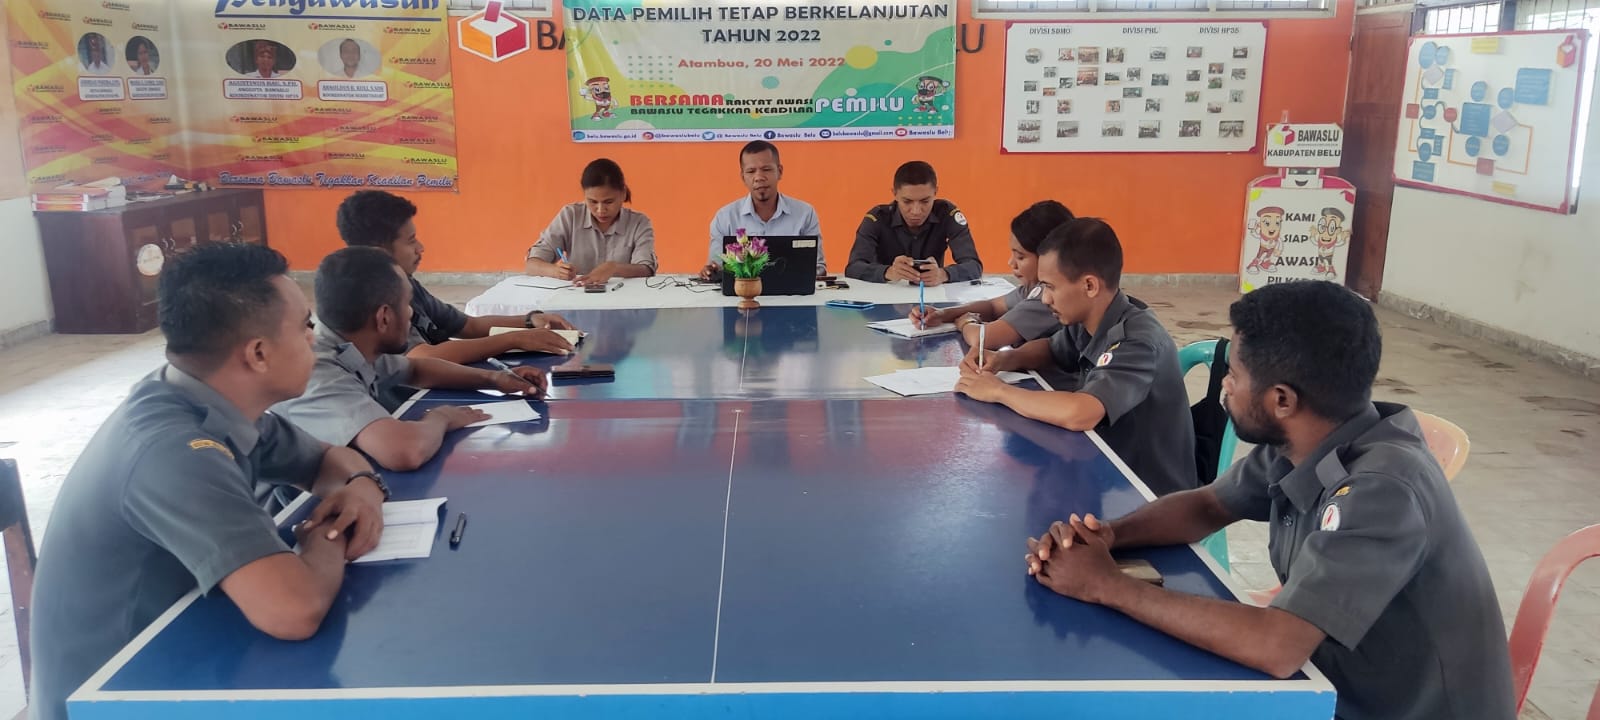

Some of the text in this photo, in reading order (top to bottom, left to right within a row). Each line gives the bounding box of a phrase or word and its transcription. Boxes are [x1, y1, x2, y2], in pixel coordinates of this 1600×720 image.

[573, 4, 949, 21] DATA PEMILIH TETAP BERKELANJUTAN
[702, 29, 821, 42] TAHUN 2022
[678, 57, 846, 70] Atambua, 20 Mei 2022
[630, 94, 724, 106] BERSAMA
[815, 97, 904, 113] PEMILU
[630, 107, 684, 115] BAWASLU
[755, 106, 814, 114] KEADILAN
[1297, 129, 1339, 142] BAWASLU
[1267, 149, 1341, 157] KABUPATEN BELU
[218, 172, 265, 185] Bersama
[268, 172, 313, 185] Bawaslu
[315, 173, 364, 188] Tegakkan
[416, 174, 453, 188] Pemilu
[1285, 213, 1316, 223] KAMI
[1283, 234, 1309, 243] SIAP
[1275, 256, 1319, 267] AWASI
